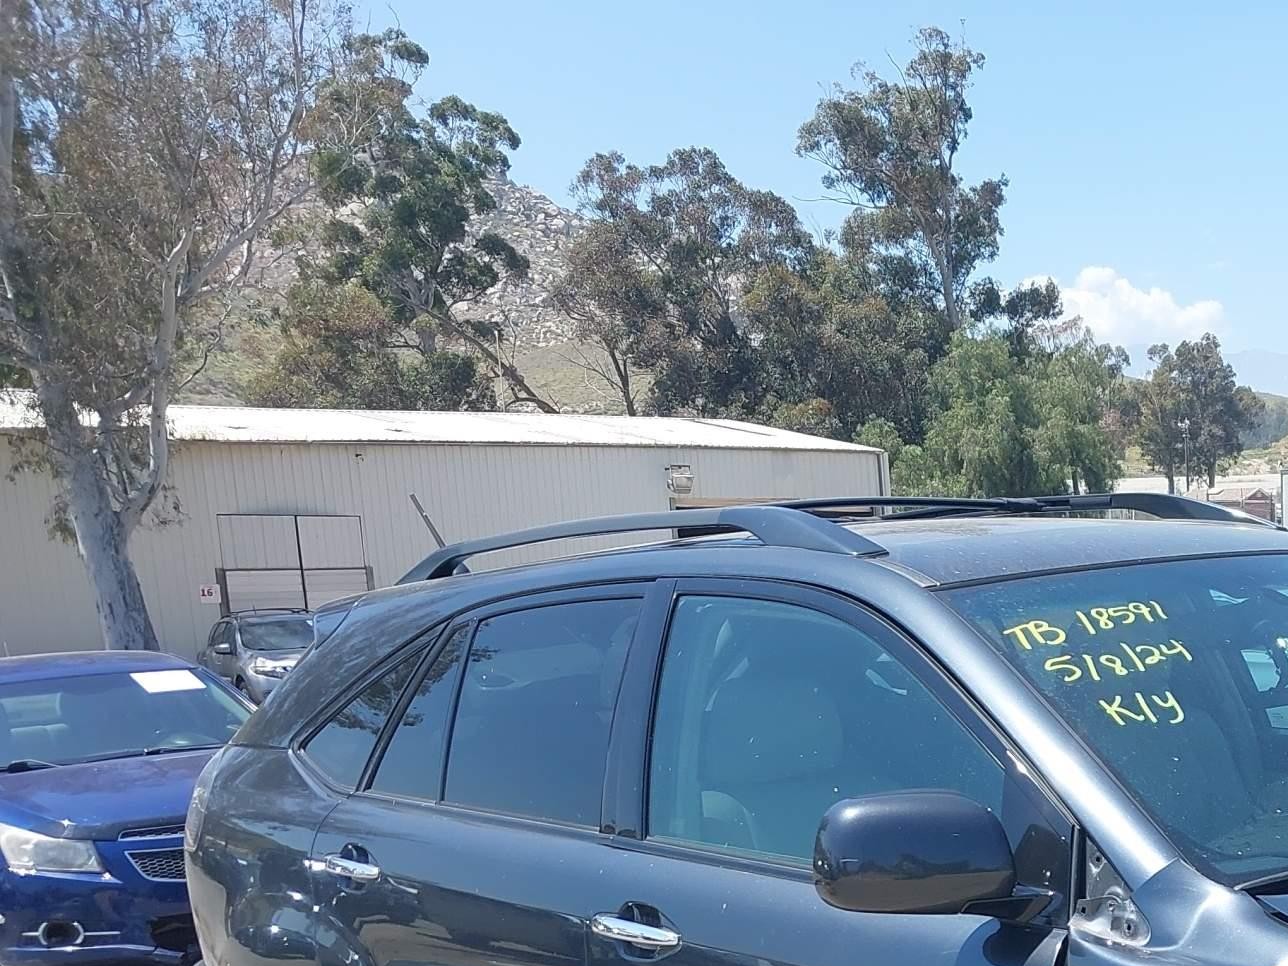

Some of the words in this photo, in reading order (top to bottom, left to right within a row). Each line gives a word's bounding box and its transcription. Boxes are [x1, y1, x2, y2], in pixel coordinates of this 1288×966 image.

[201, 588, 214, 597] 16
[1003, 620, 1067, 650] TB
[1076, 600, 1169, 636] 18591
[1044, 639, 1193, 682] 5/8/24
